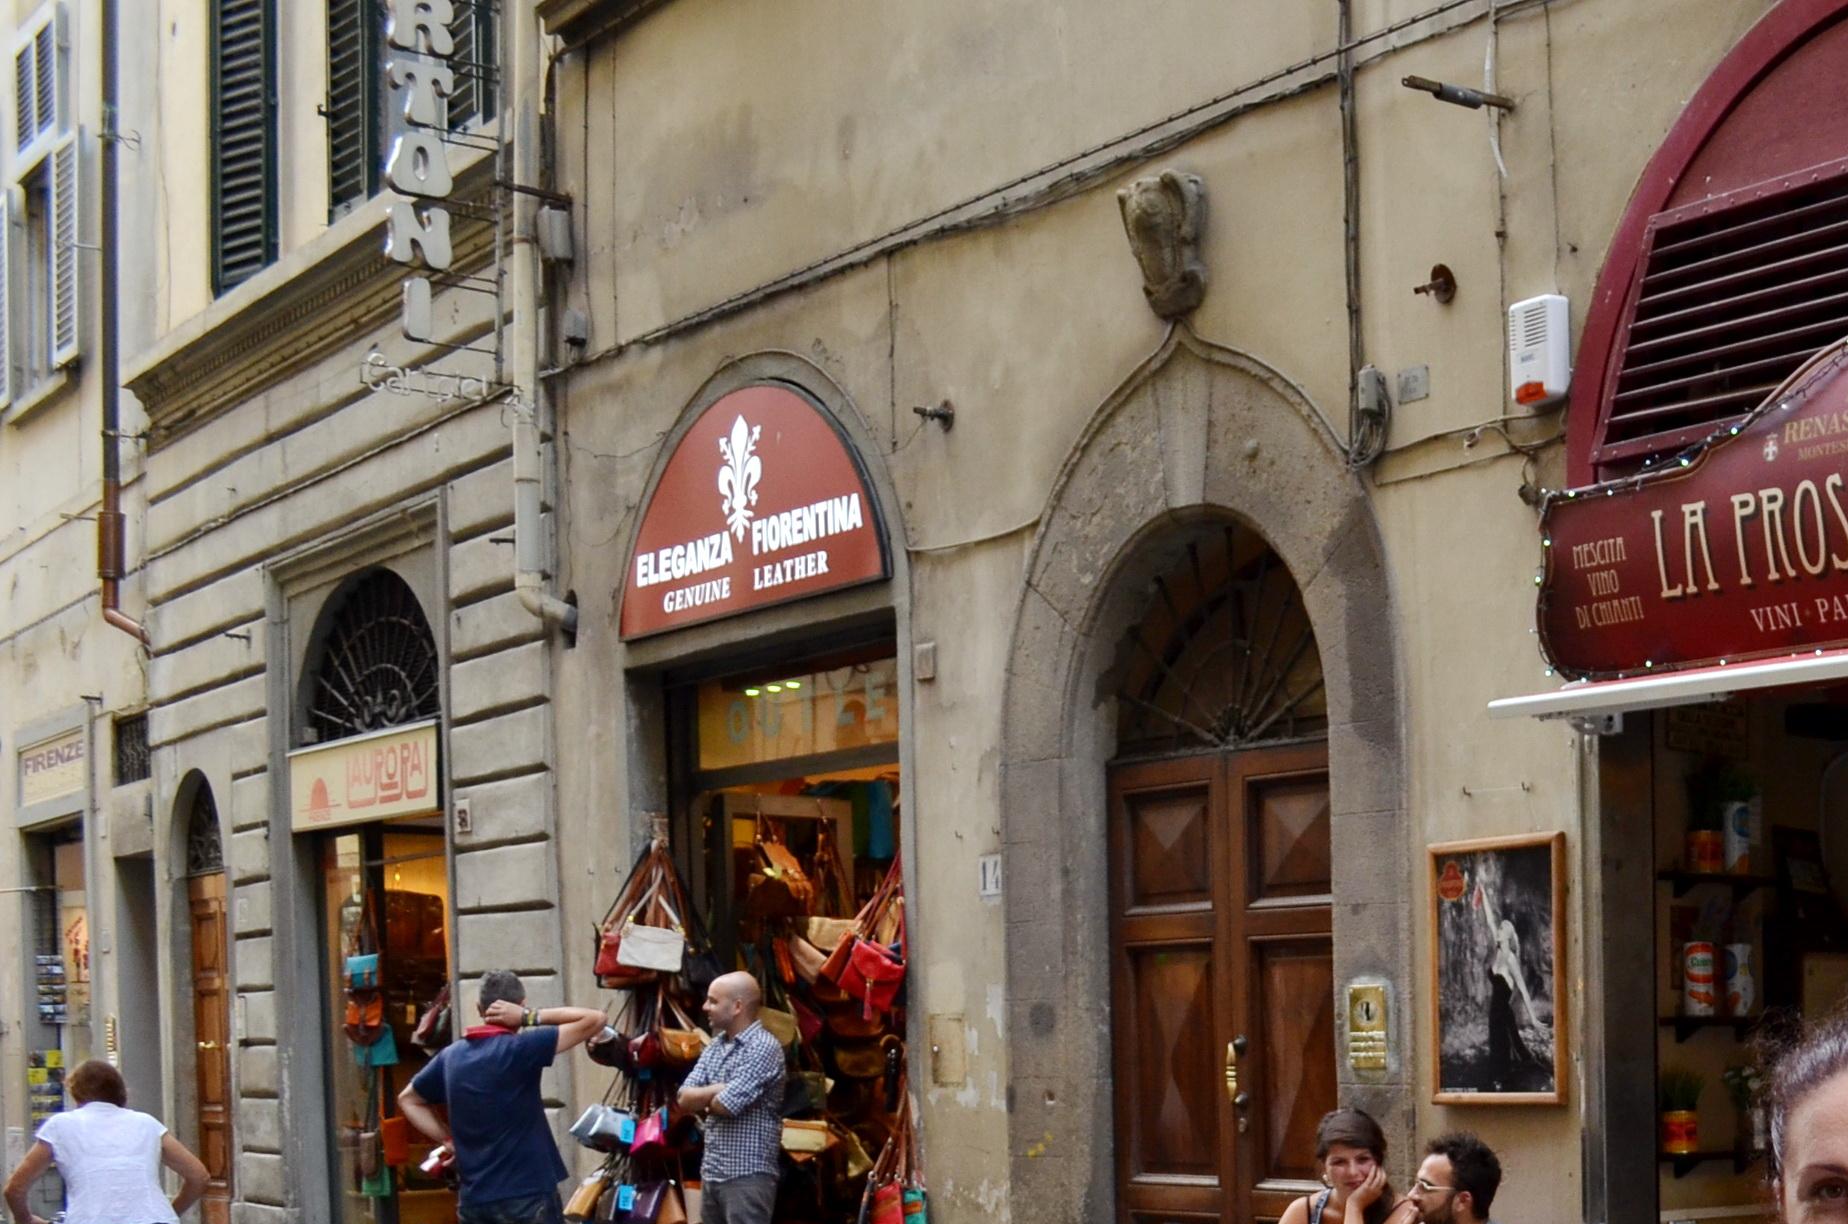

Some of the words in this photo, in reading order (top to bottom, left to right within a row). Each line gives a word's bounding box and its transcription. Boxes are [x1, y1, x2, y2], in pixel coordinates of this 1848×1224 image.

[636, 530, 733, 588] ELEGANZA
[752, 492, 863, 556] FIORENTINA
[1572, 536, 1627, 570] MESCITA
[1651, 500, 1719, 598] LA
[663, 577, 731, 614] GENUINE
[753, 550, 829, 591] LEATHER
[1586, 569, 1620, 596] VINO
[1575, 605, 1592, 629] DI
[1594, 596, 1645, 628] CHIANTI
[1749, 603, 1803, 633] VINI
[24, 738, 84, 776] FIRENZE
[346, 736, 429, 809] AURORA
[982, 860, 999, 890] 14
